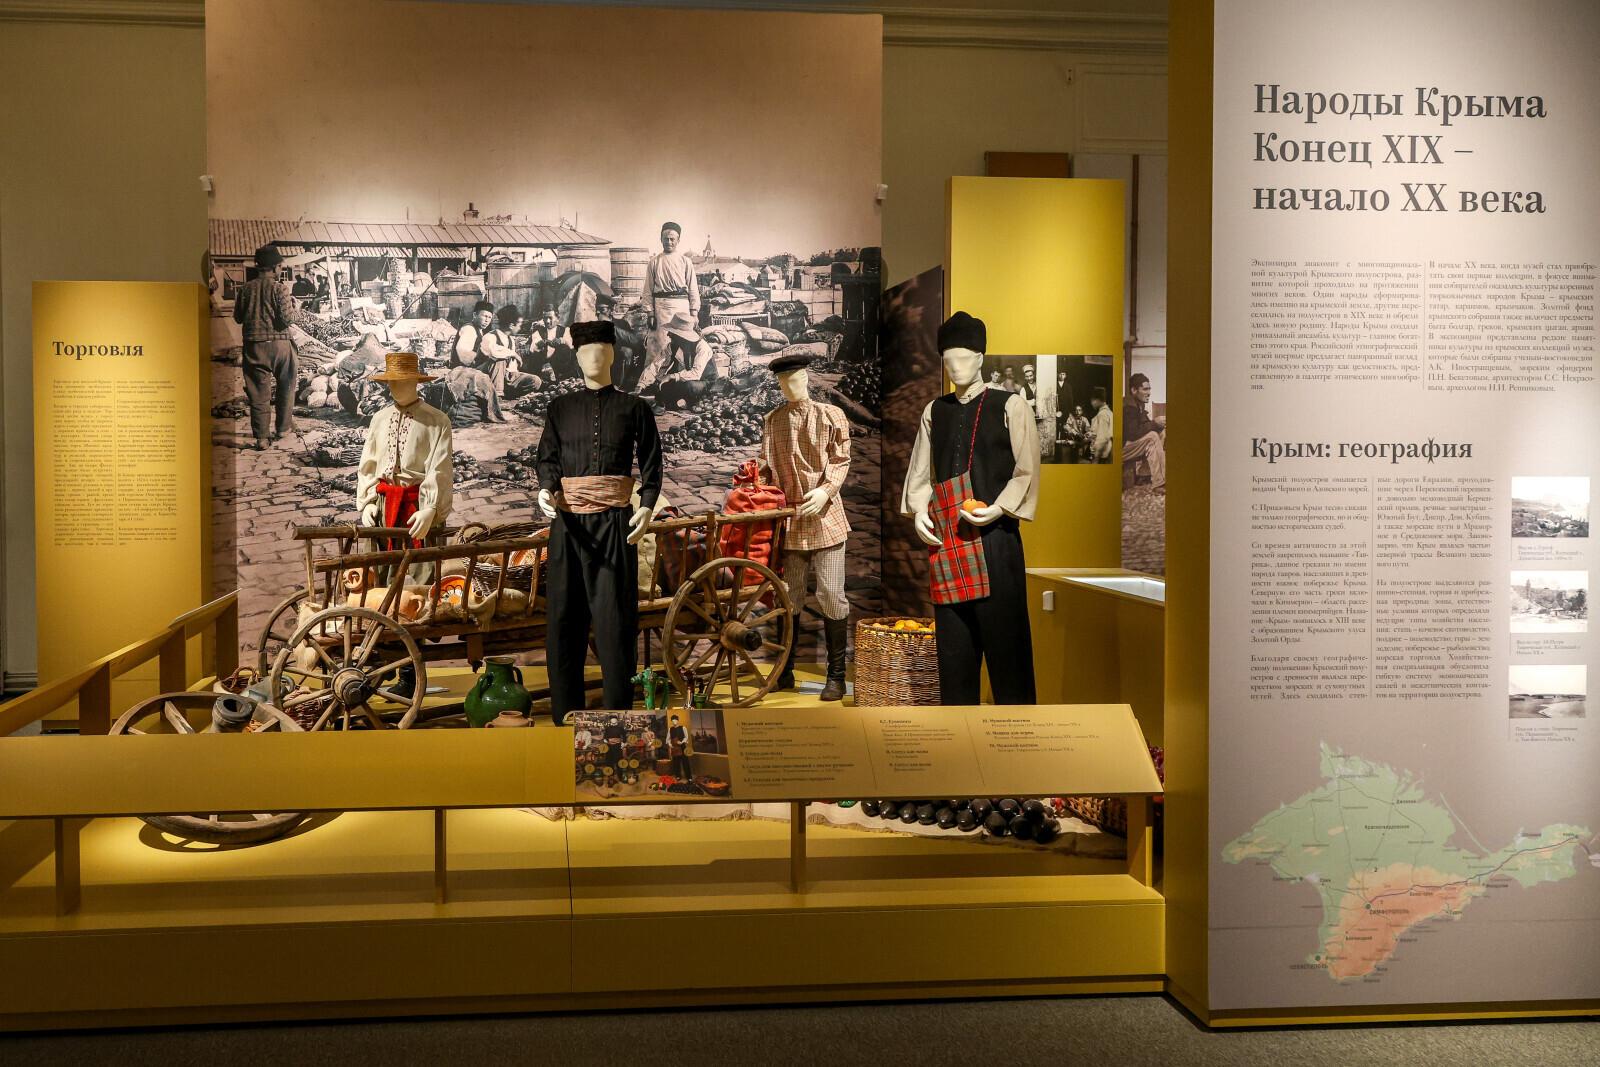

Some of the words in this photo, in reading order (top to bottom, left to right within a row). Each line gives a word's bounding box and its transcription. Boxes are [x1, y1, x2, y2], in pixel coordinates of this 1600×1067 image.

[1253, 84, 1404, 124] Народы
[1415, 87, 1548, 126] Крыма
[1253, 132, 1372, 168] Конец
[1382, 135, 1444, 164] XIX
[1253, 188, 1390, 211] начало
[1400, 183, 1448, 212] XX
[1458, 190, 1547, 213] века
[53, 341, 144, 360] Торговля
[1251, 438, 1331, 464] Крым:
[1338, 437, 1472, 464] география
